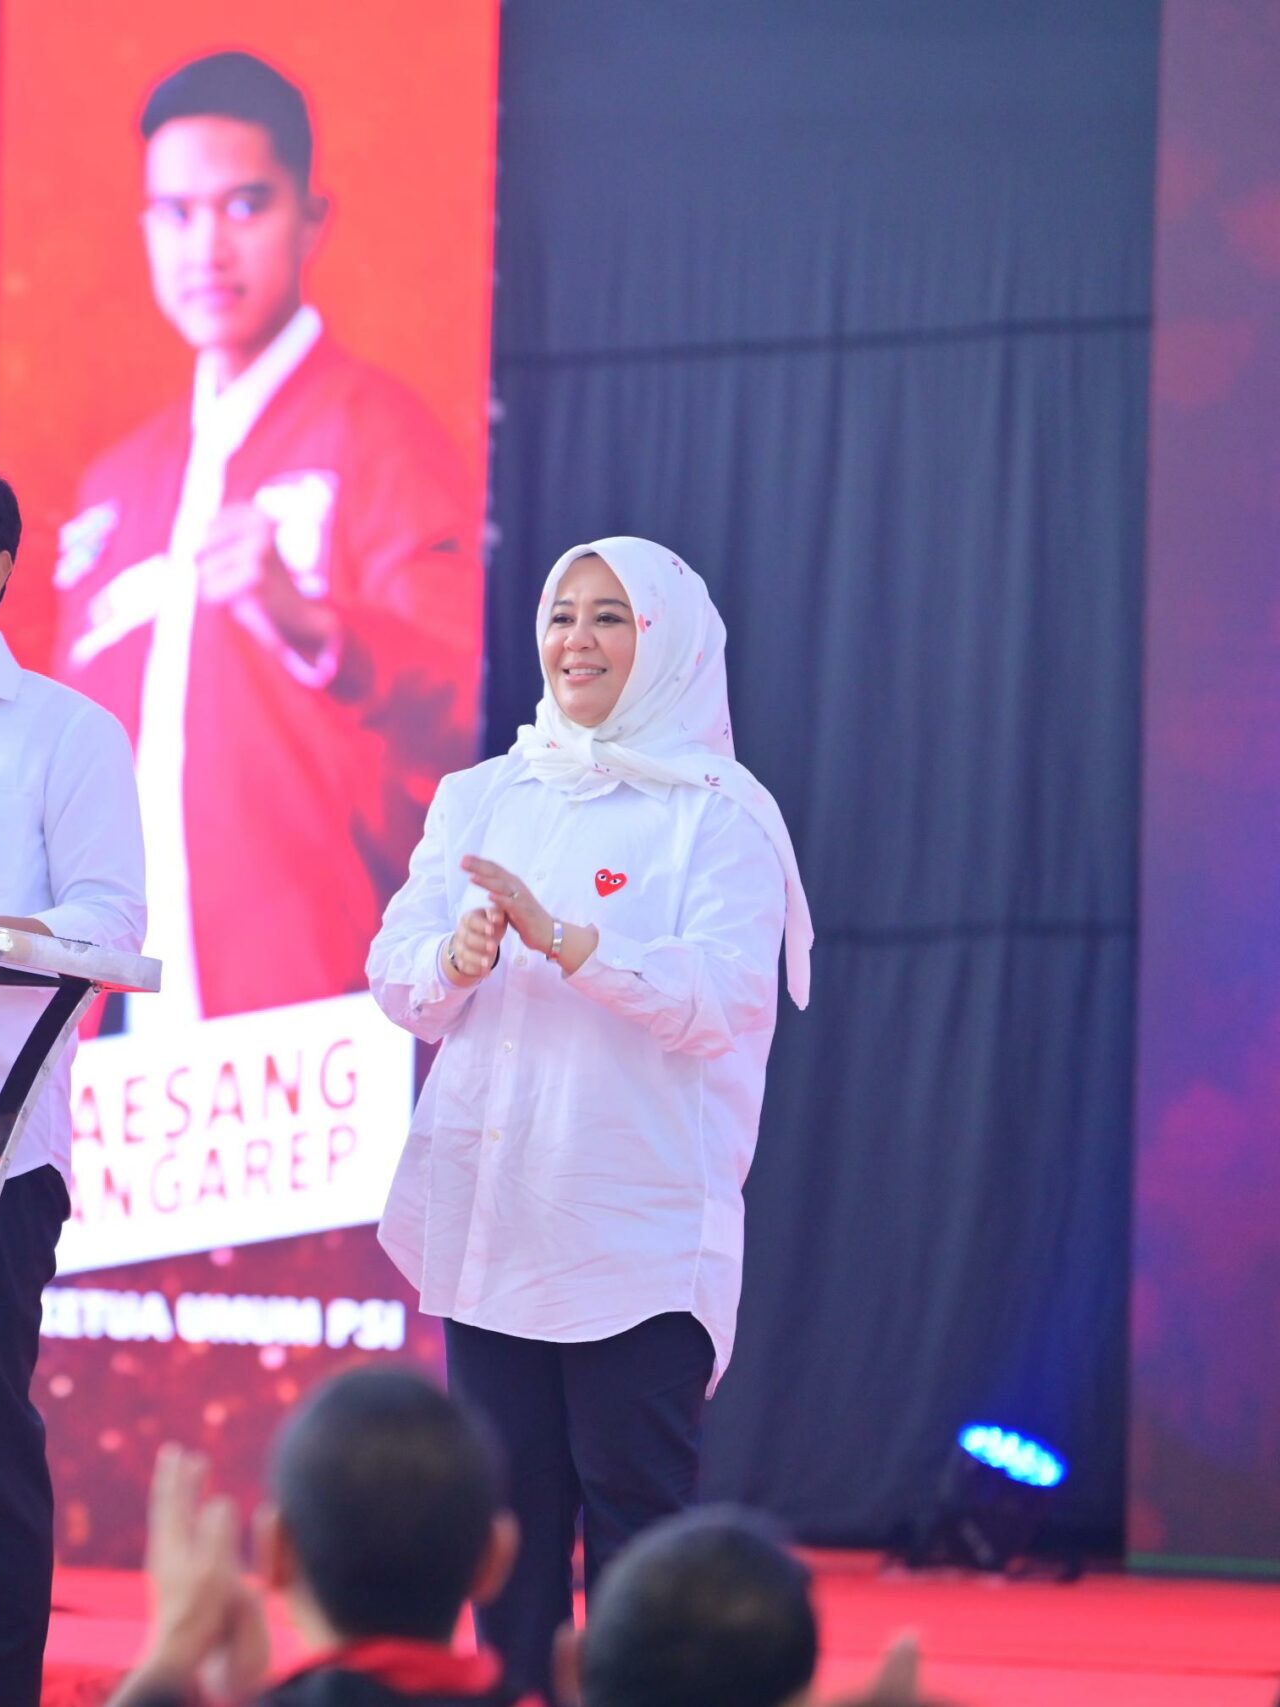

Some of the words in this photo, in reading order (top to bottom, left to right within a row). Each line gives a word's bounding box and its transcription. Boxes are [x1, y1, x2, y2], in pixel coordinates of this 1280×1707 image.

[71, 1037, 358, 1149] AESANG
[70, 1124, 358, 1224] NGAREP
[325, 1297, 407, 1351] PSI
